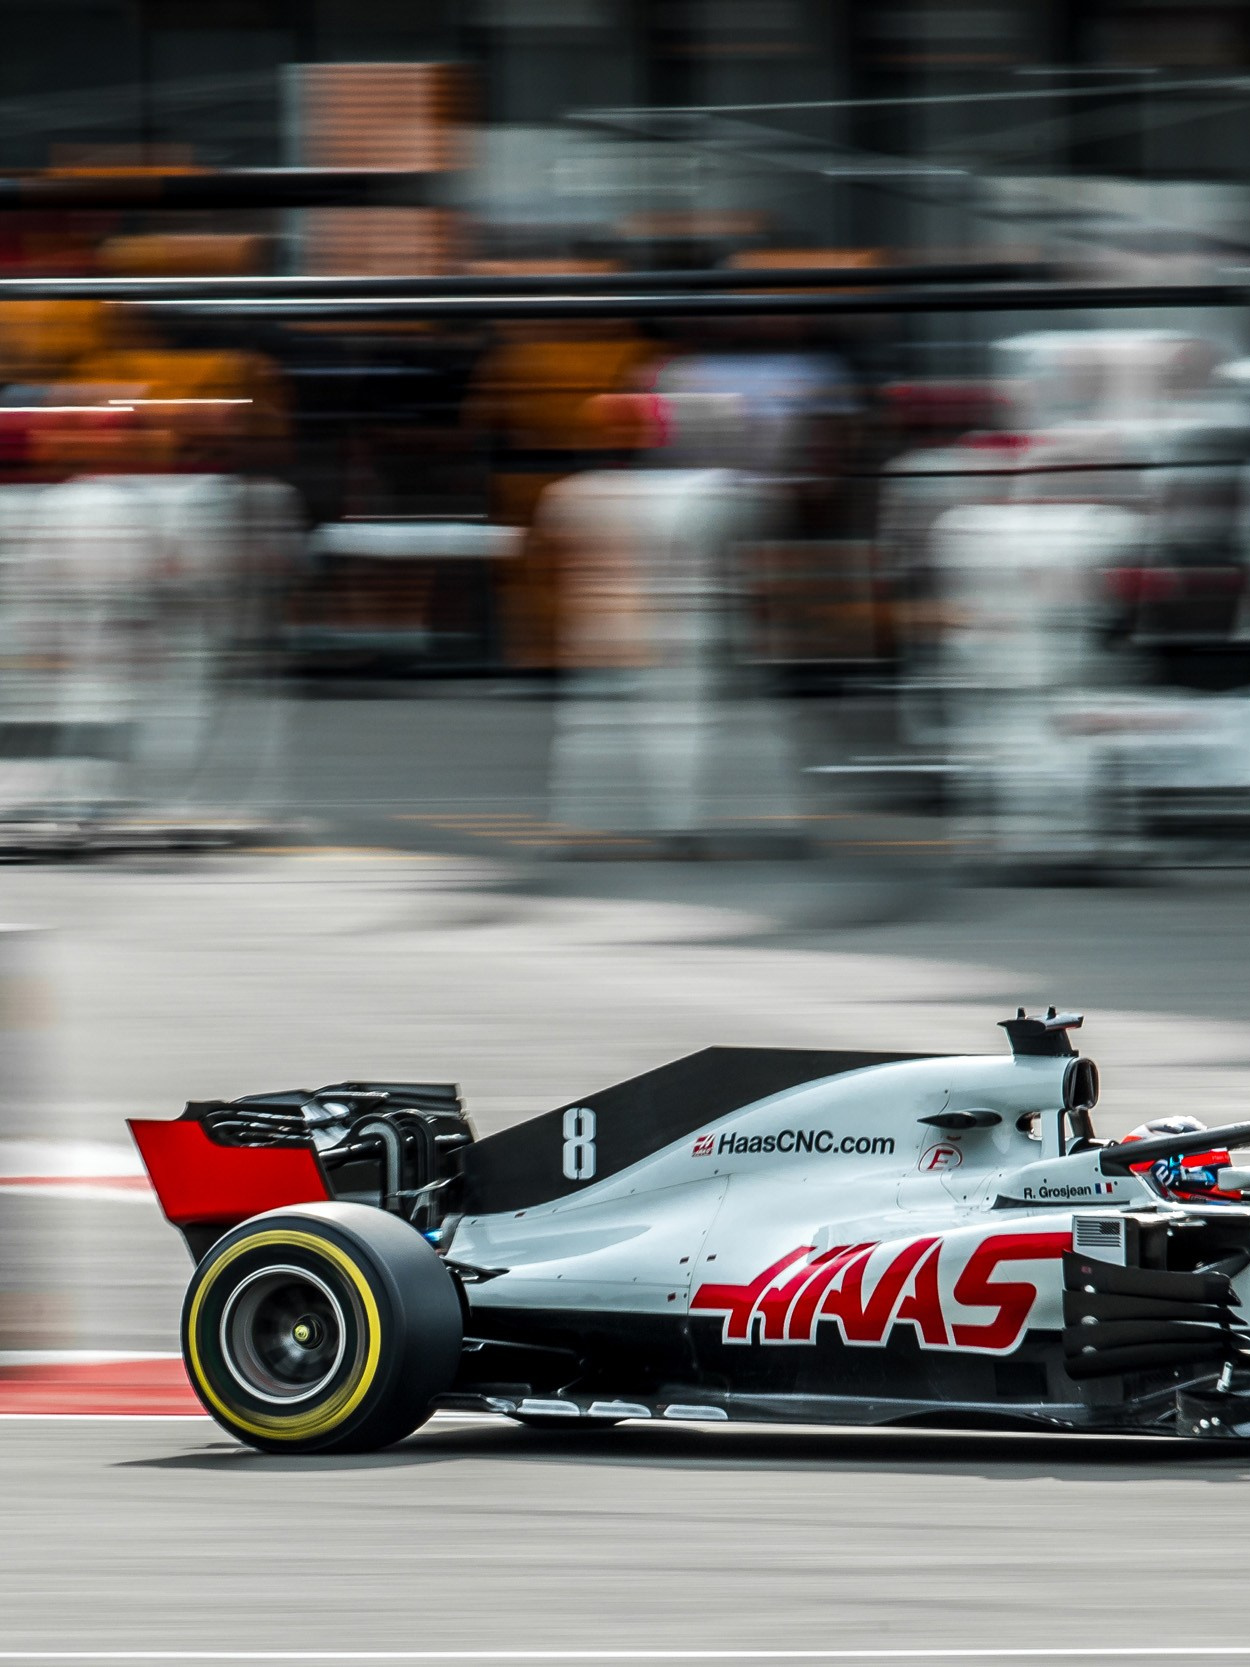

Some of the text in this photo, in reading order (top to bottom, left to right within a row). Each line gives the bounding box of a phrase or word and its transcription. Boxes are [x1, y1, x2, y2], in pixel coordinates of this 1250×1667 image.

[563, 1107, 597, 1180] 8
[717, 1129, 895, 1155] HaasCNC.com
[1023, 1184, 1092, 1200] R. Grosjean
[690, 1231, 1072, 1350] HAAS
